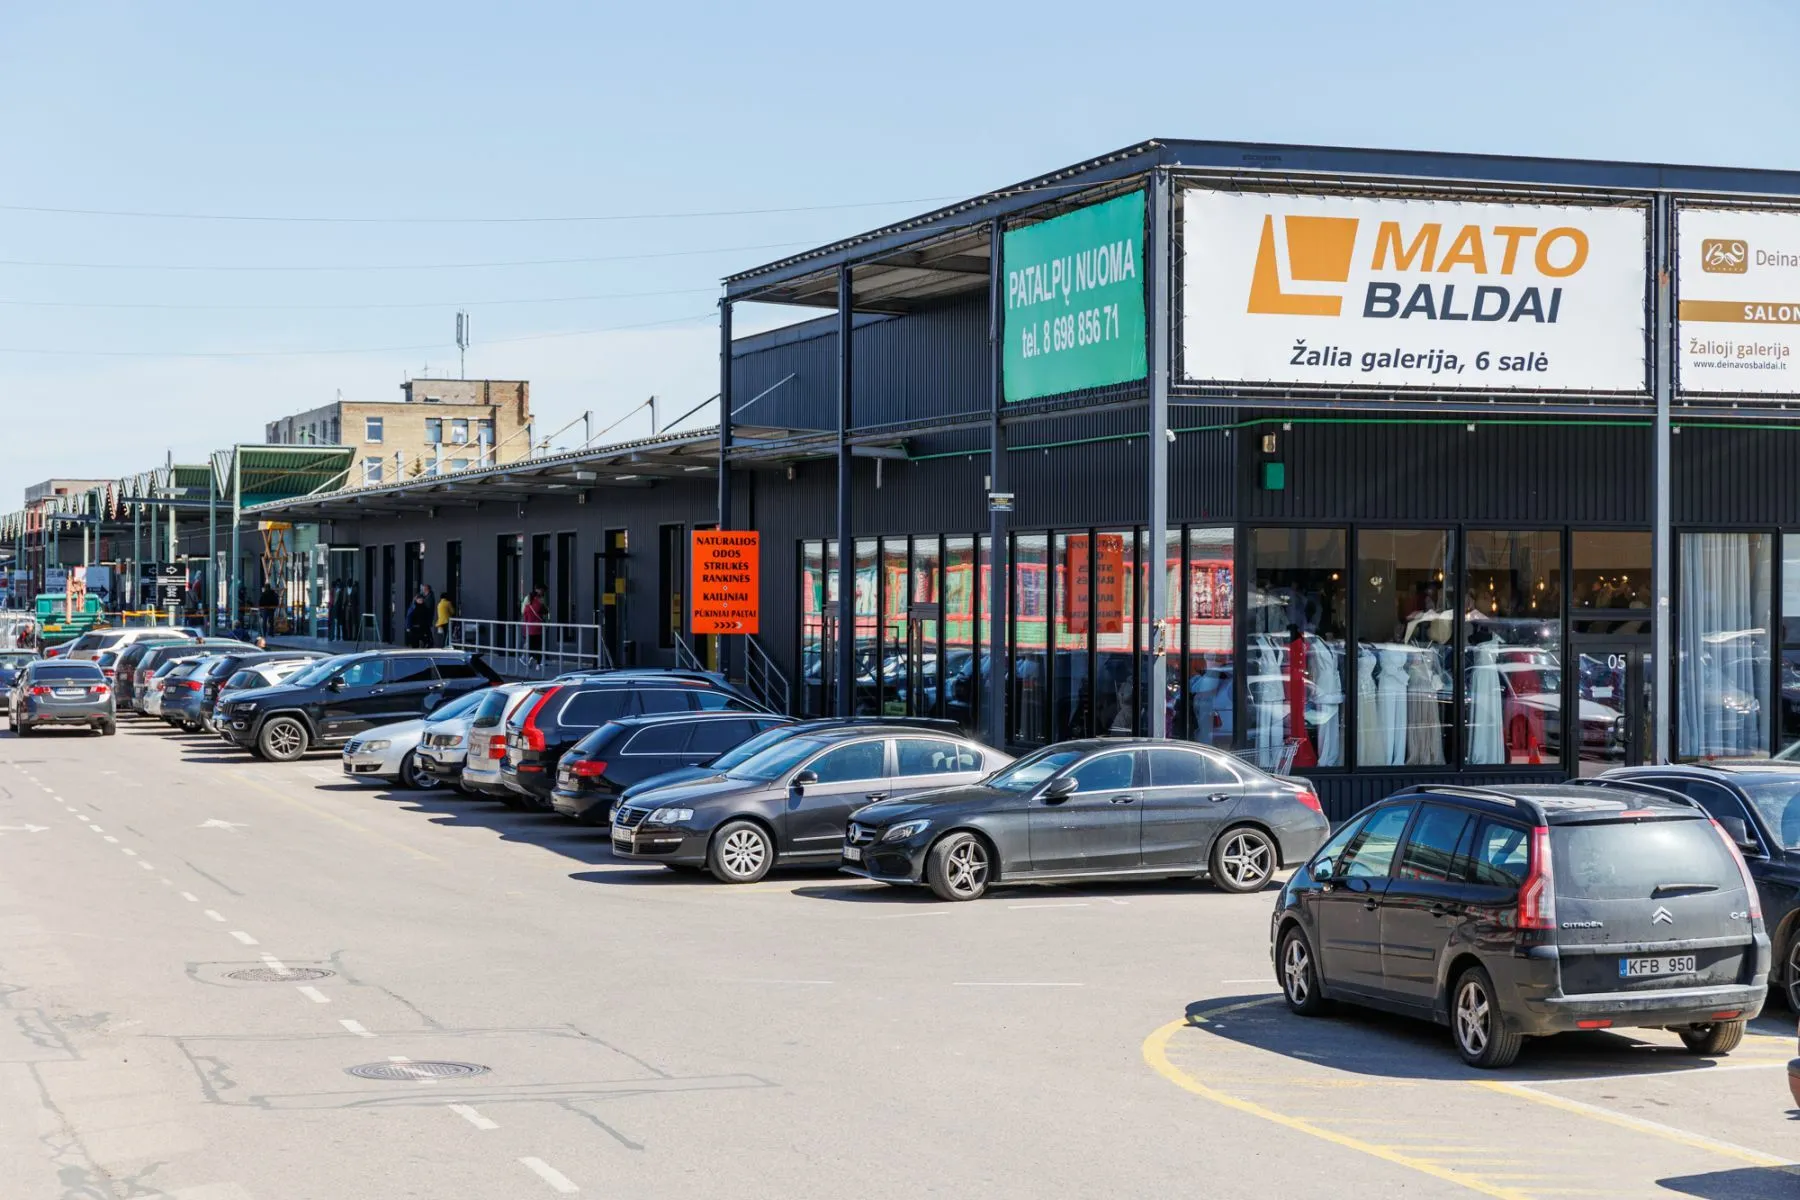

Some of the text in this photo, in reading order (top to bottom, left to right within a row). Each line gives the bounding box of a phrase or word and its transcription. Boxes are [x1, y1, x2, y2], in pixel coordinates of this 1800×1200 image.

[1370, 221, 1590, 278] MATO
[1756, 249, 1800, 267] Deina
[1009, 239, 1136, 310] PATALPŲ NUOMA
[1362, 281, 1563, 323] BALDAI
[1022, 303, 1119, 358] tel. 8 698 856 71
[1290, 339, 1549, 374] Žalia galerija, 6 salė
[1690, 337, 1790, 360] Žalioji galerija
[1693, 360, 1787, 370] www.deinavosbaldai.lt
[696, 537, 757, 546] NATURALIOS
[712, 550, 741, 558] ODOS
[703, 593, 748, 601] KAILINIAI
[1608, 654, 1626, 669] 05
[1629, 960, 1660, 974] KFB
[1669, 957, 1694, 972] 950
